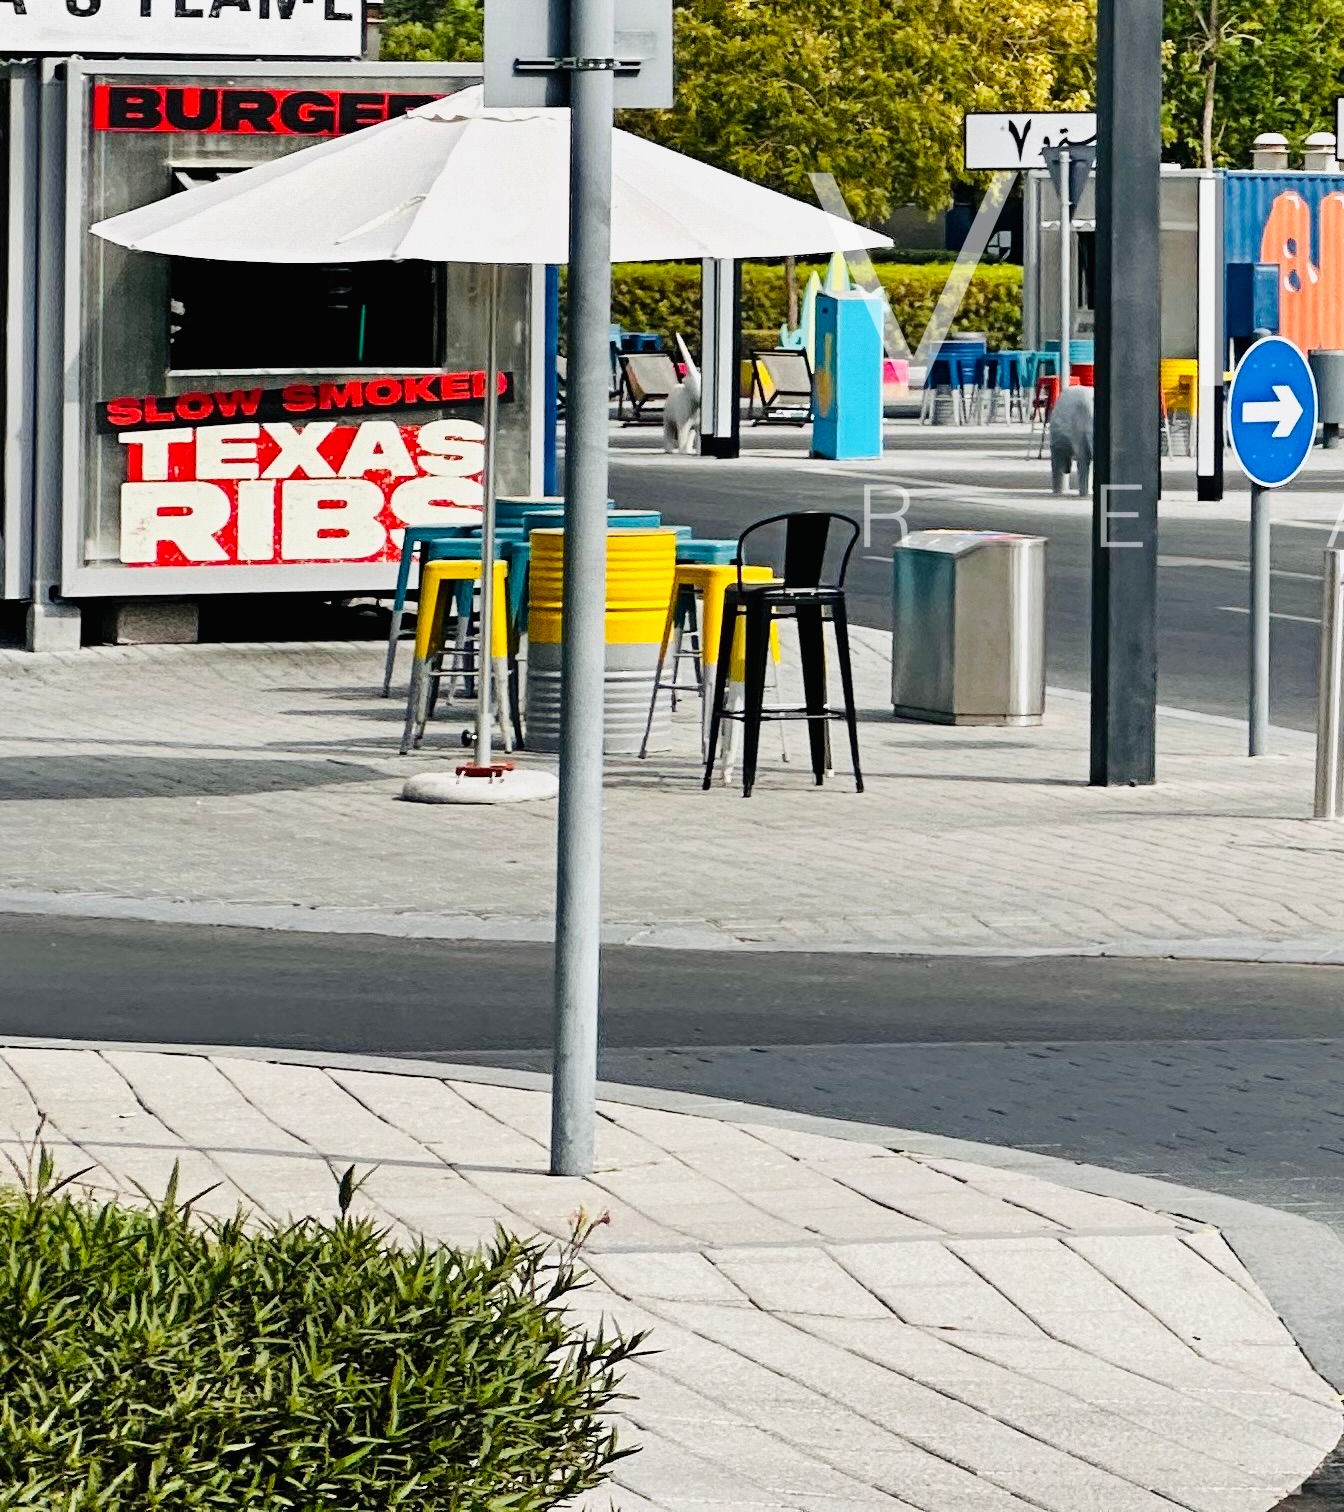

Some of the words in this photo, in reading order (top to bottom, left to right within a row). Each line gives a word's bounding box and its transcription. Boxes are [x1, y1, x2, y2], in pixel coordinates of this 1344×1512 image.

[106, 387, 263, 426] SLOW
[282, 370, 508, 412] SMOKED
[118, 419, 487, 482] TEXAS
